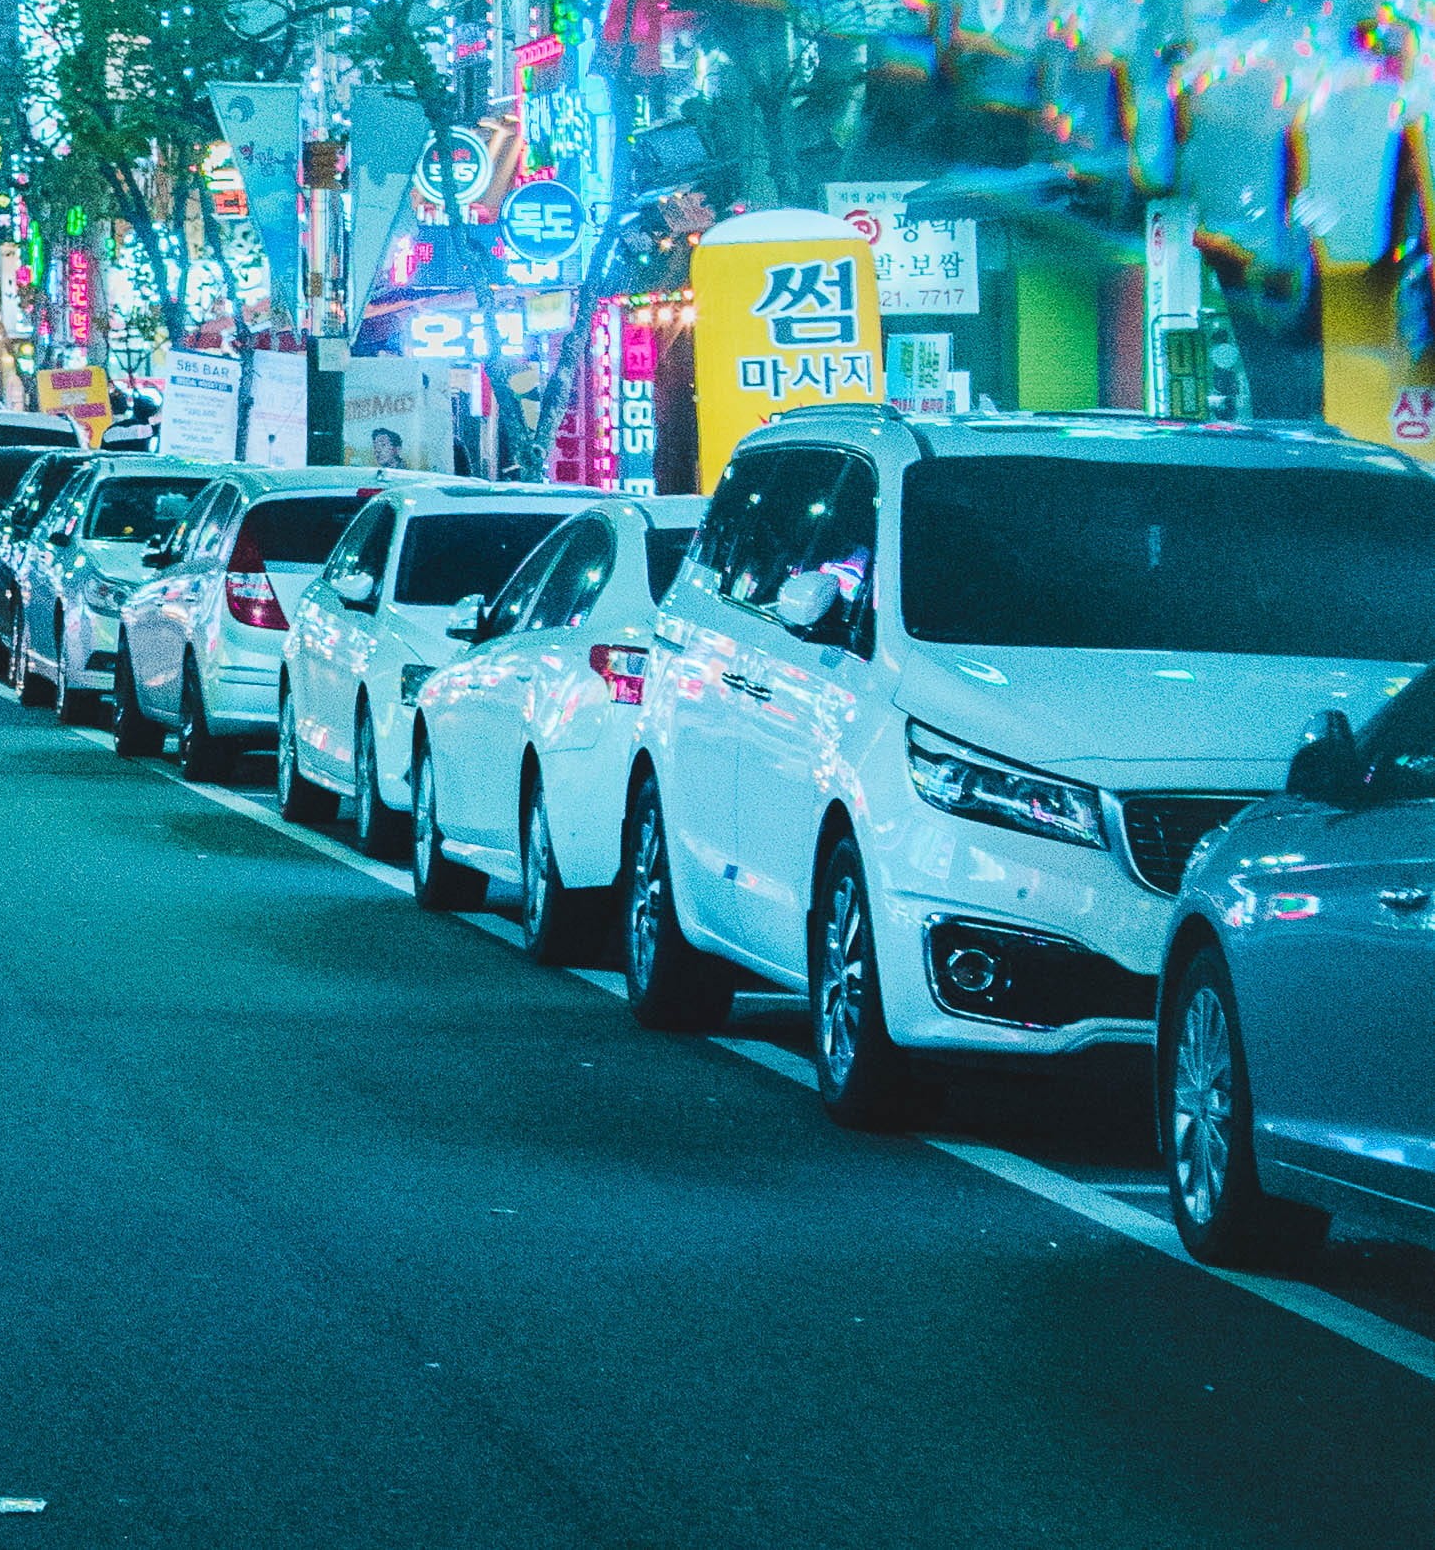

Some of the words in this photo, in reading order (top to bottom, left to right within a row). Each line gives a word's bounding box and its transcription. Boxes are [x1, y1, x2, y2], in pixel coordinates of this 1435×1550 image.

[512, 203, 574, 243] 독도
[754, 257, 857, 345] 썸
[918, 289, 966, 306] 7717
[176, 359, 199, 373] 585
[203, 363, 230, 378] BAR
[740, 355, 873, 397] 마사지
[623, 380, 654, 455] 585
